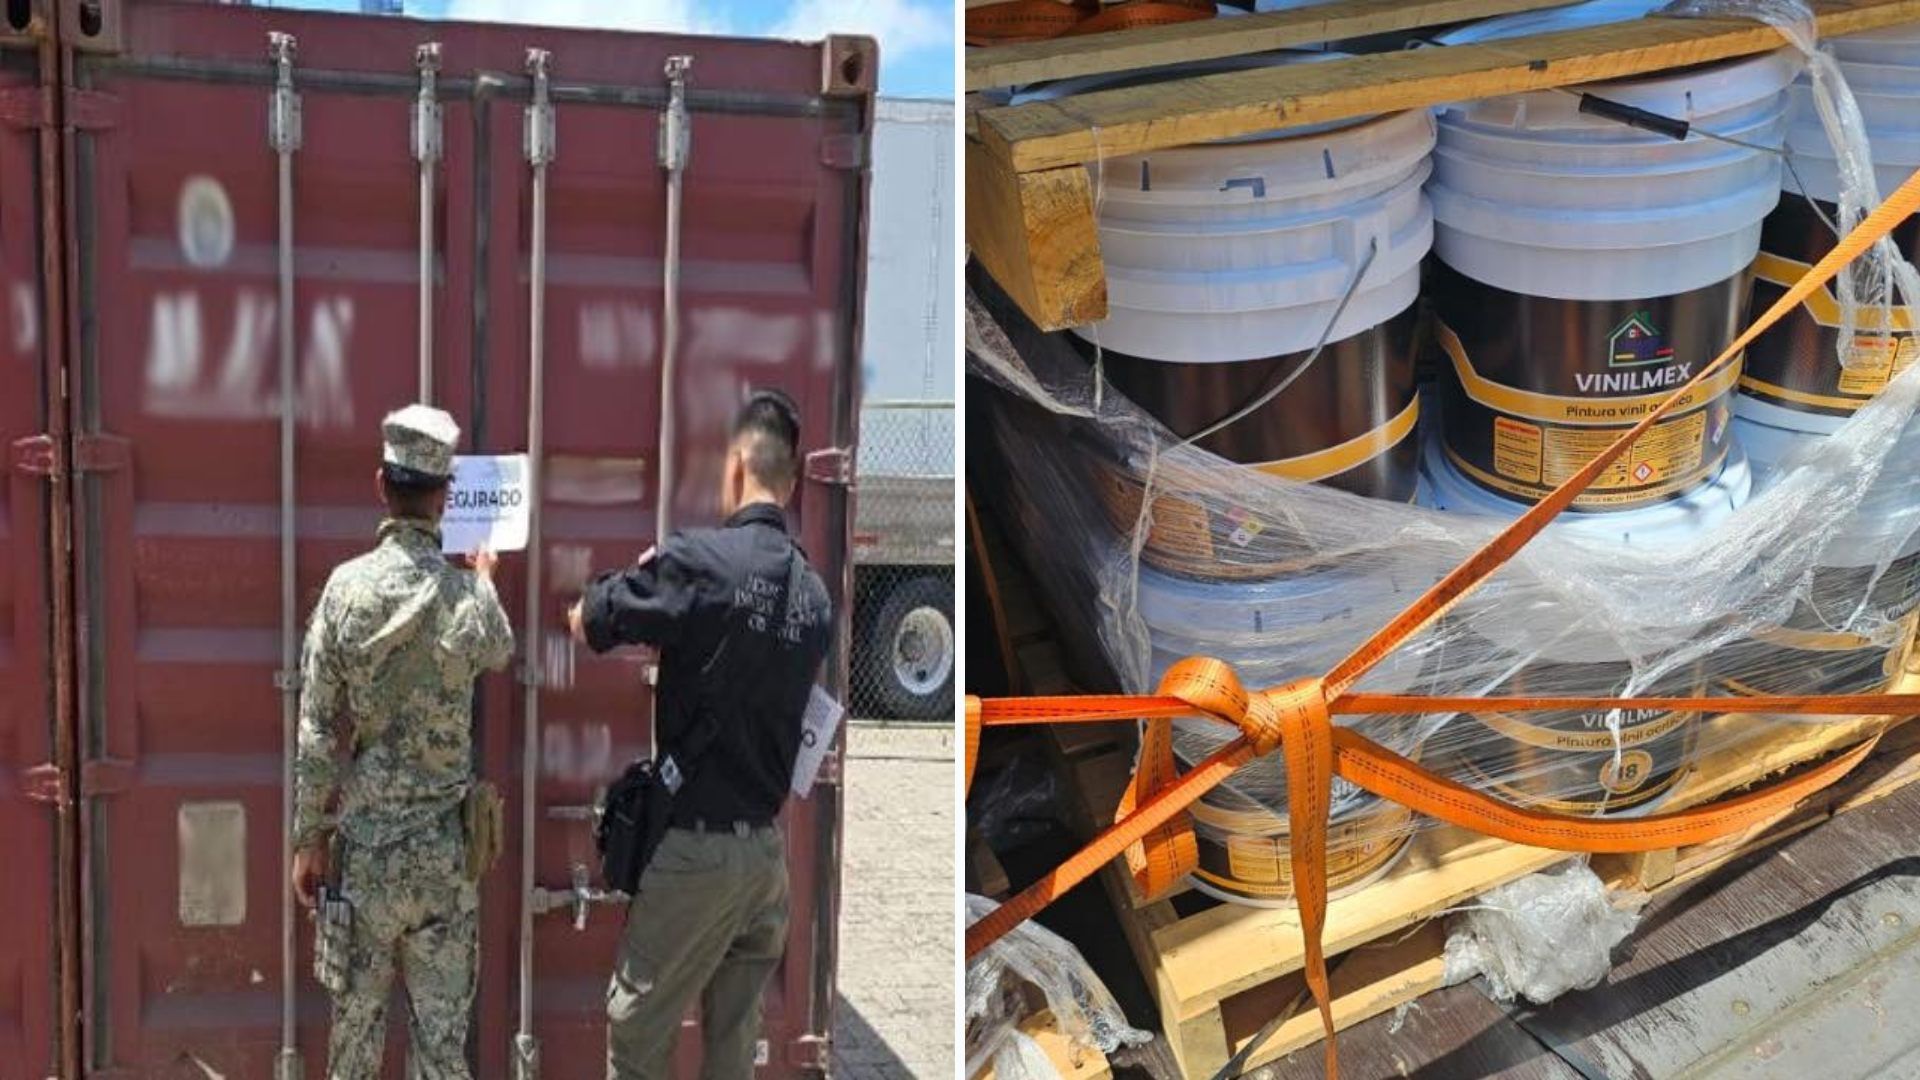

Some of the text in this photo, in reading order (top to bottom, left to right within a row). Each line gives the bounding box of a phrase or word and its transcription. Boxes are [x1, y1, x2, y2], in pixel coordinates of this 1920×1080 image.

[1575, 362, 1692, 392] VINILMEX
[1566, 405, 1616, 417] Pintura
[1620, 403, 1646, 415] vinil
